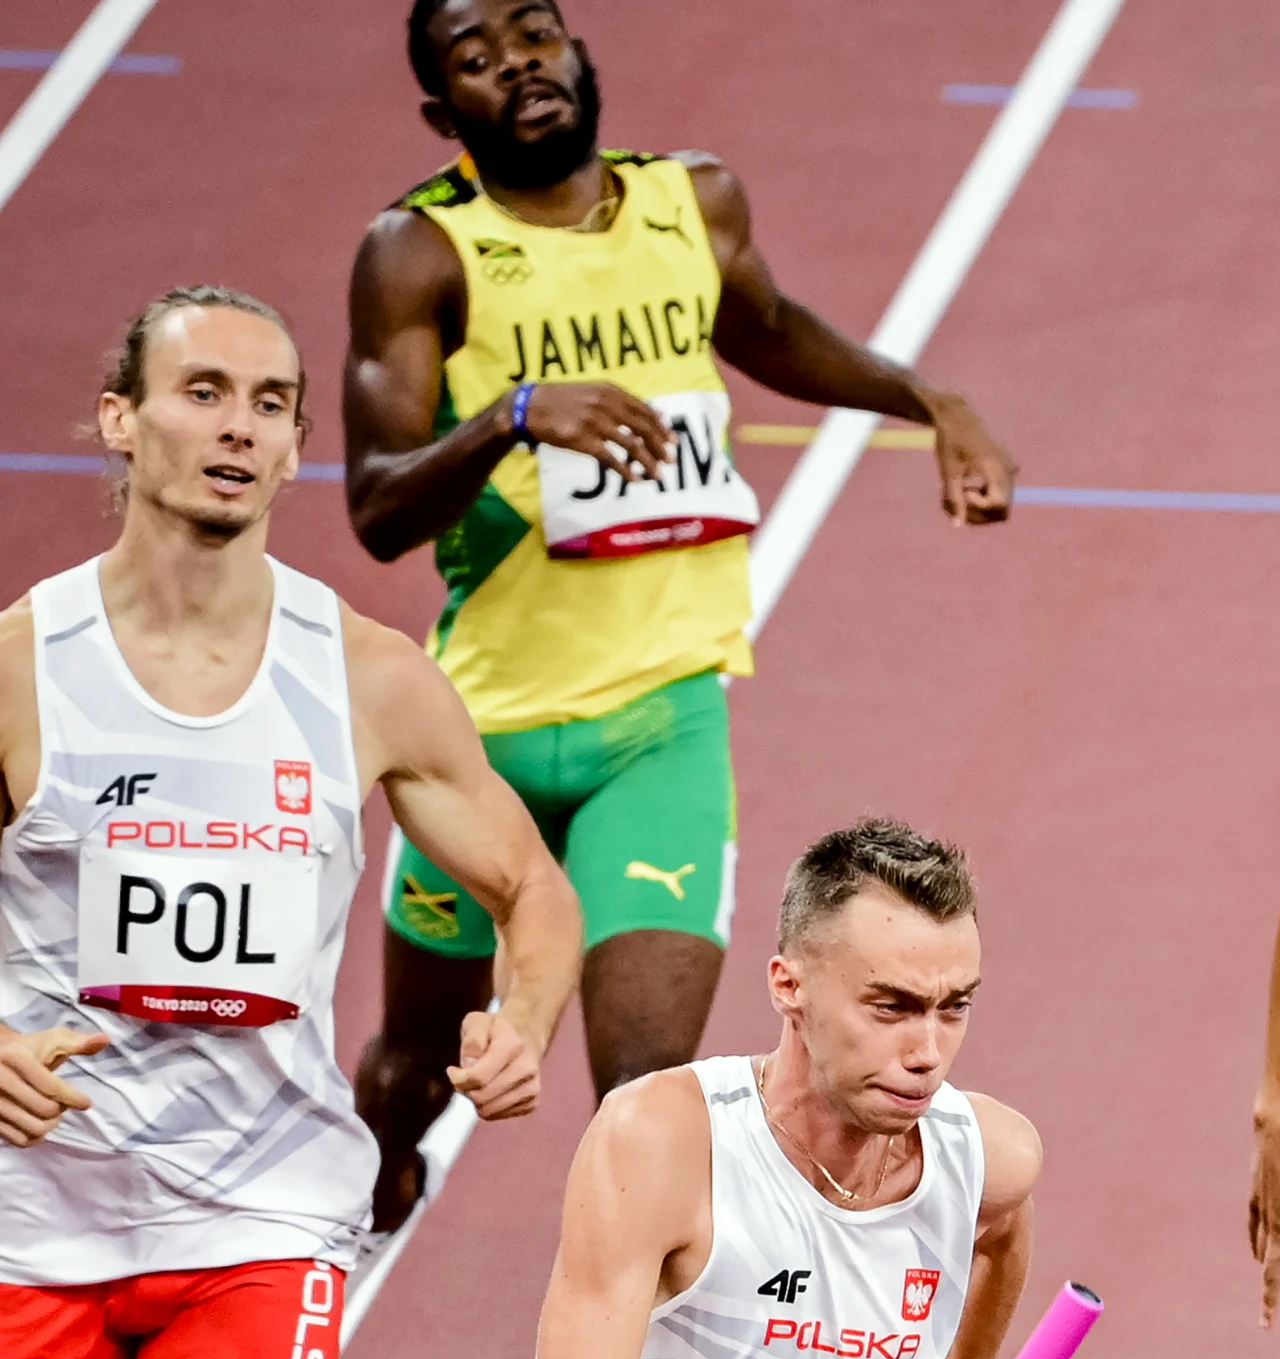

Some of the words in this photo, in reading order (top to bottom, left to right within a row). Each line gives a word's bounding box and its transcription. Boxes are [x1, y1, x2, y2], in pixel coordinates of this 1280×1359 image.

[107, 821, 310, 857] POLSKA
[116, 874, 276, 965] POL
[142, 995, 179, 1011] TOKYO
[907, 1269, 940, 1281] POLSKA
